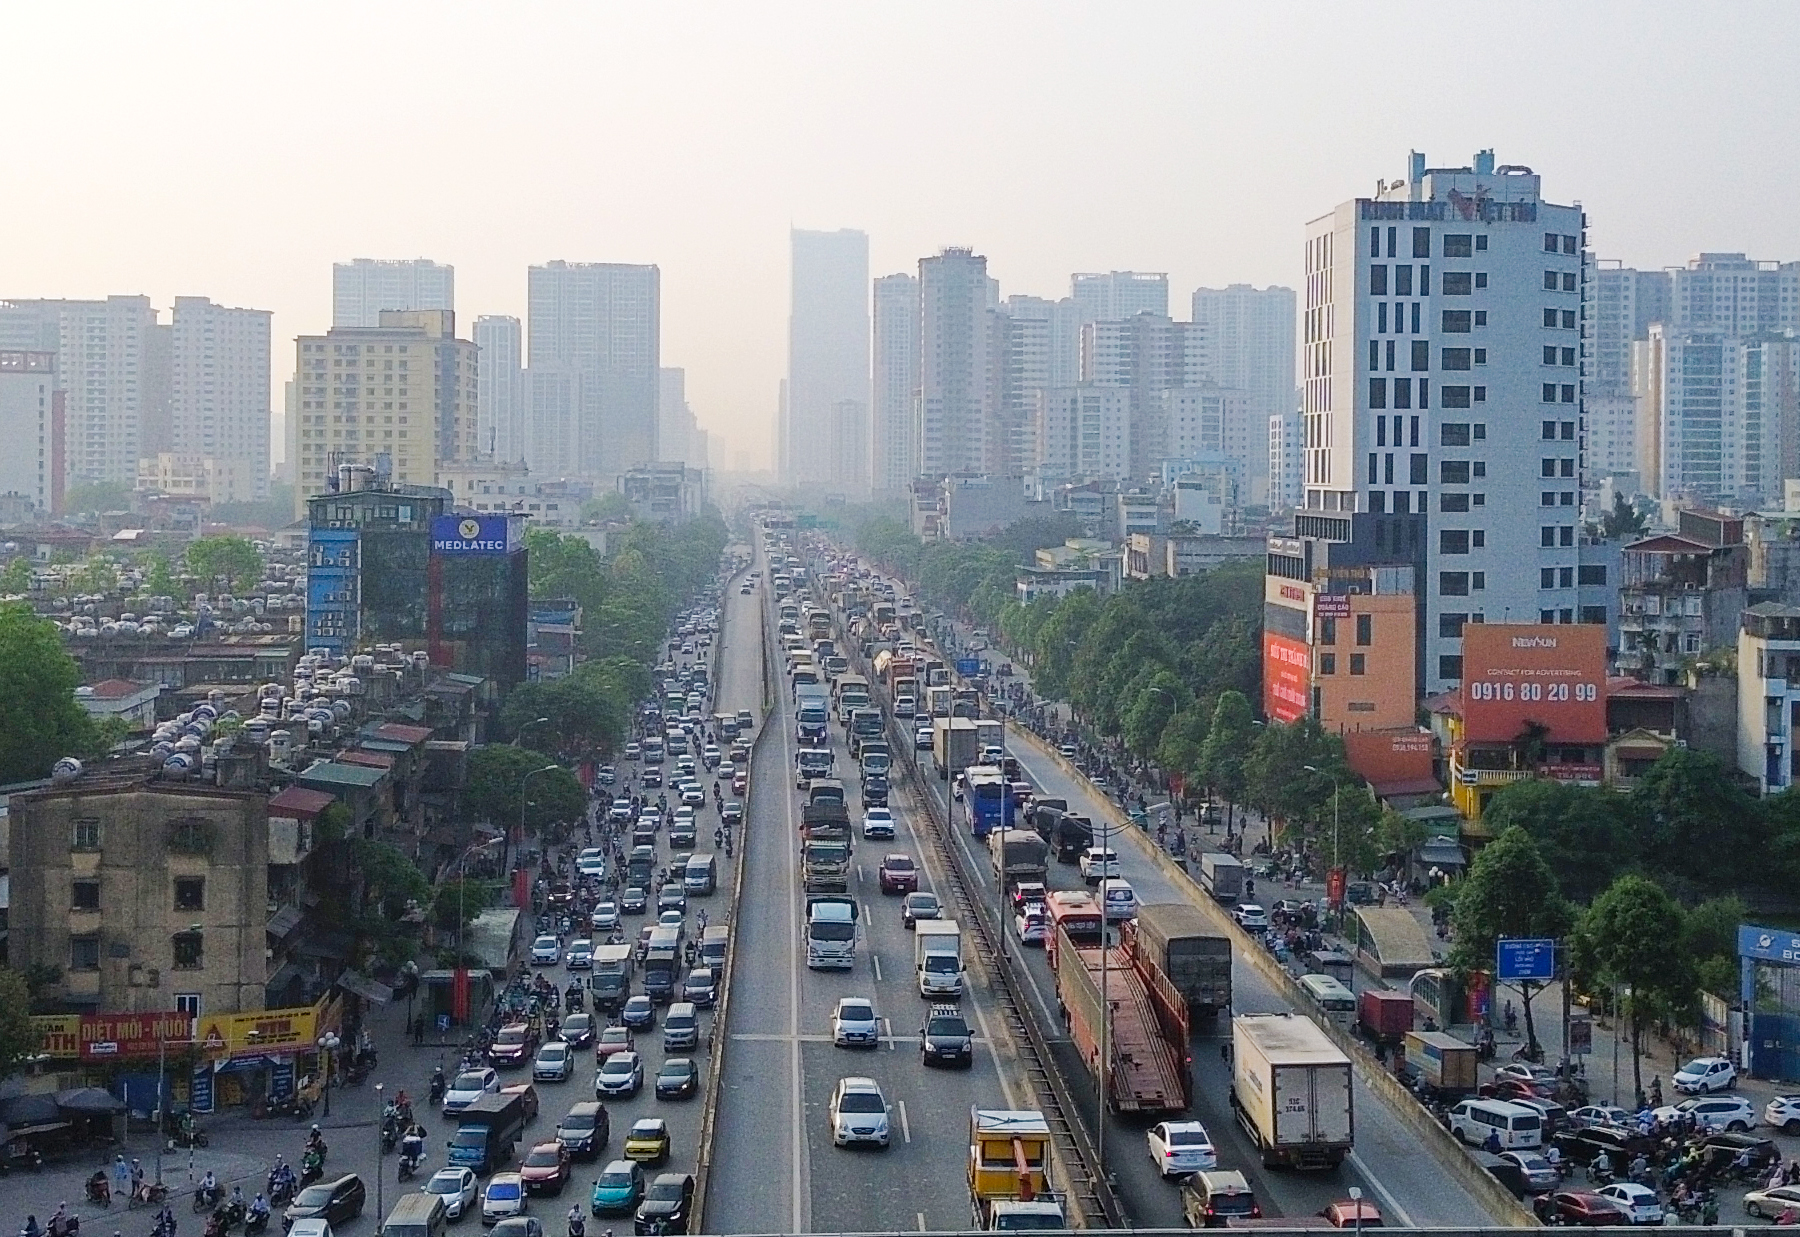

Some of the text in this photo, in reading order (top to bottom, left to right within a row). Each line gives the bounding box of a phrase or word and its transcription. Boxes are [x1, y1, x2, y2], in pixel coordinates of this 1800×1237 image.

[434, 540, 504, 550] MEDLATEC
[1487, 668, 1582, 676] CONTACT FOR ADVERTISING
[1471, 682, 1597, 702] 0916 80 20 99
